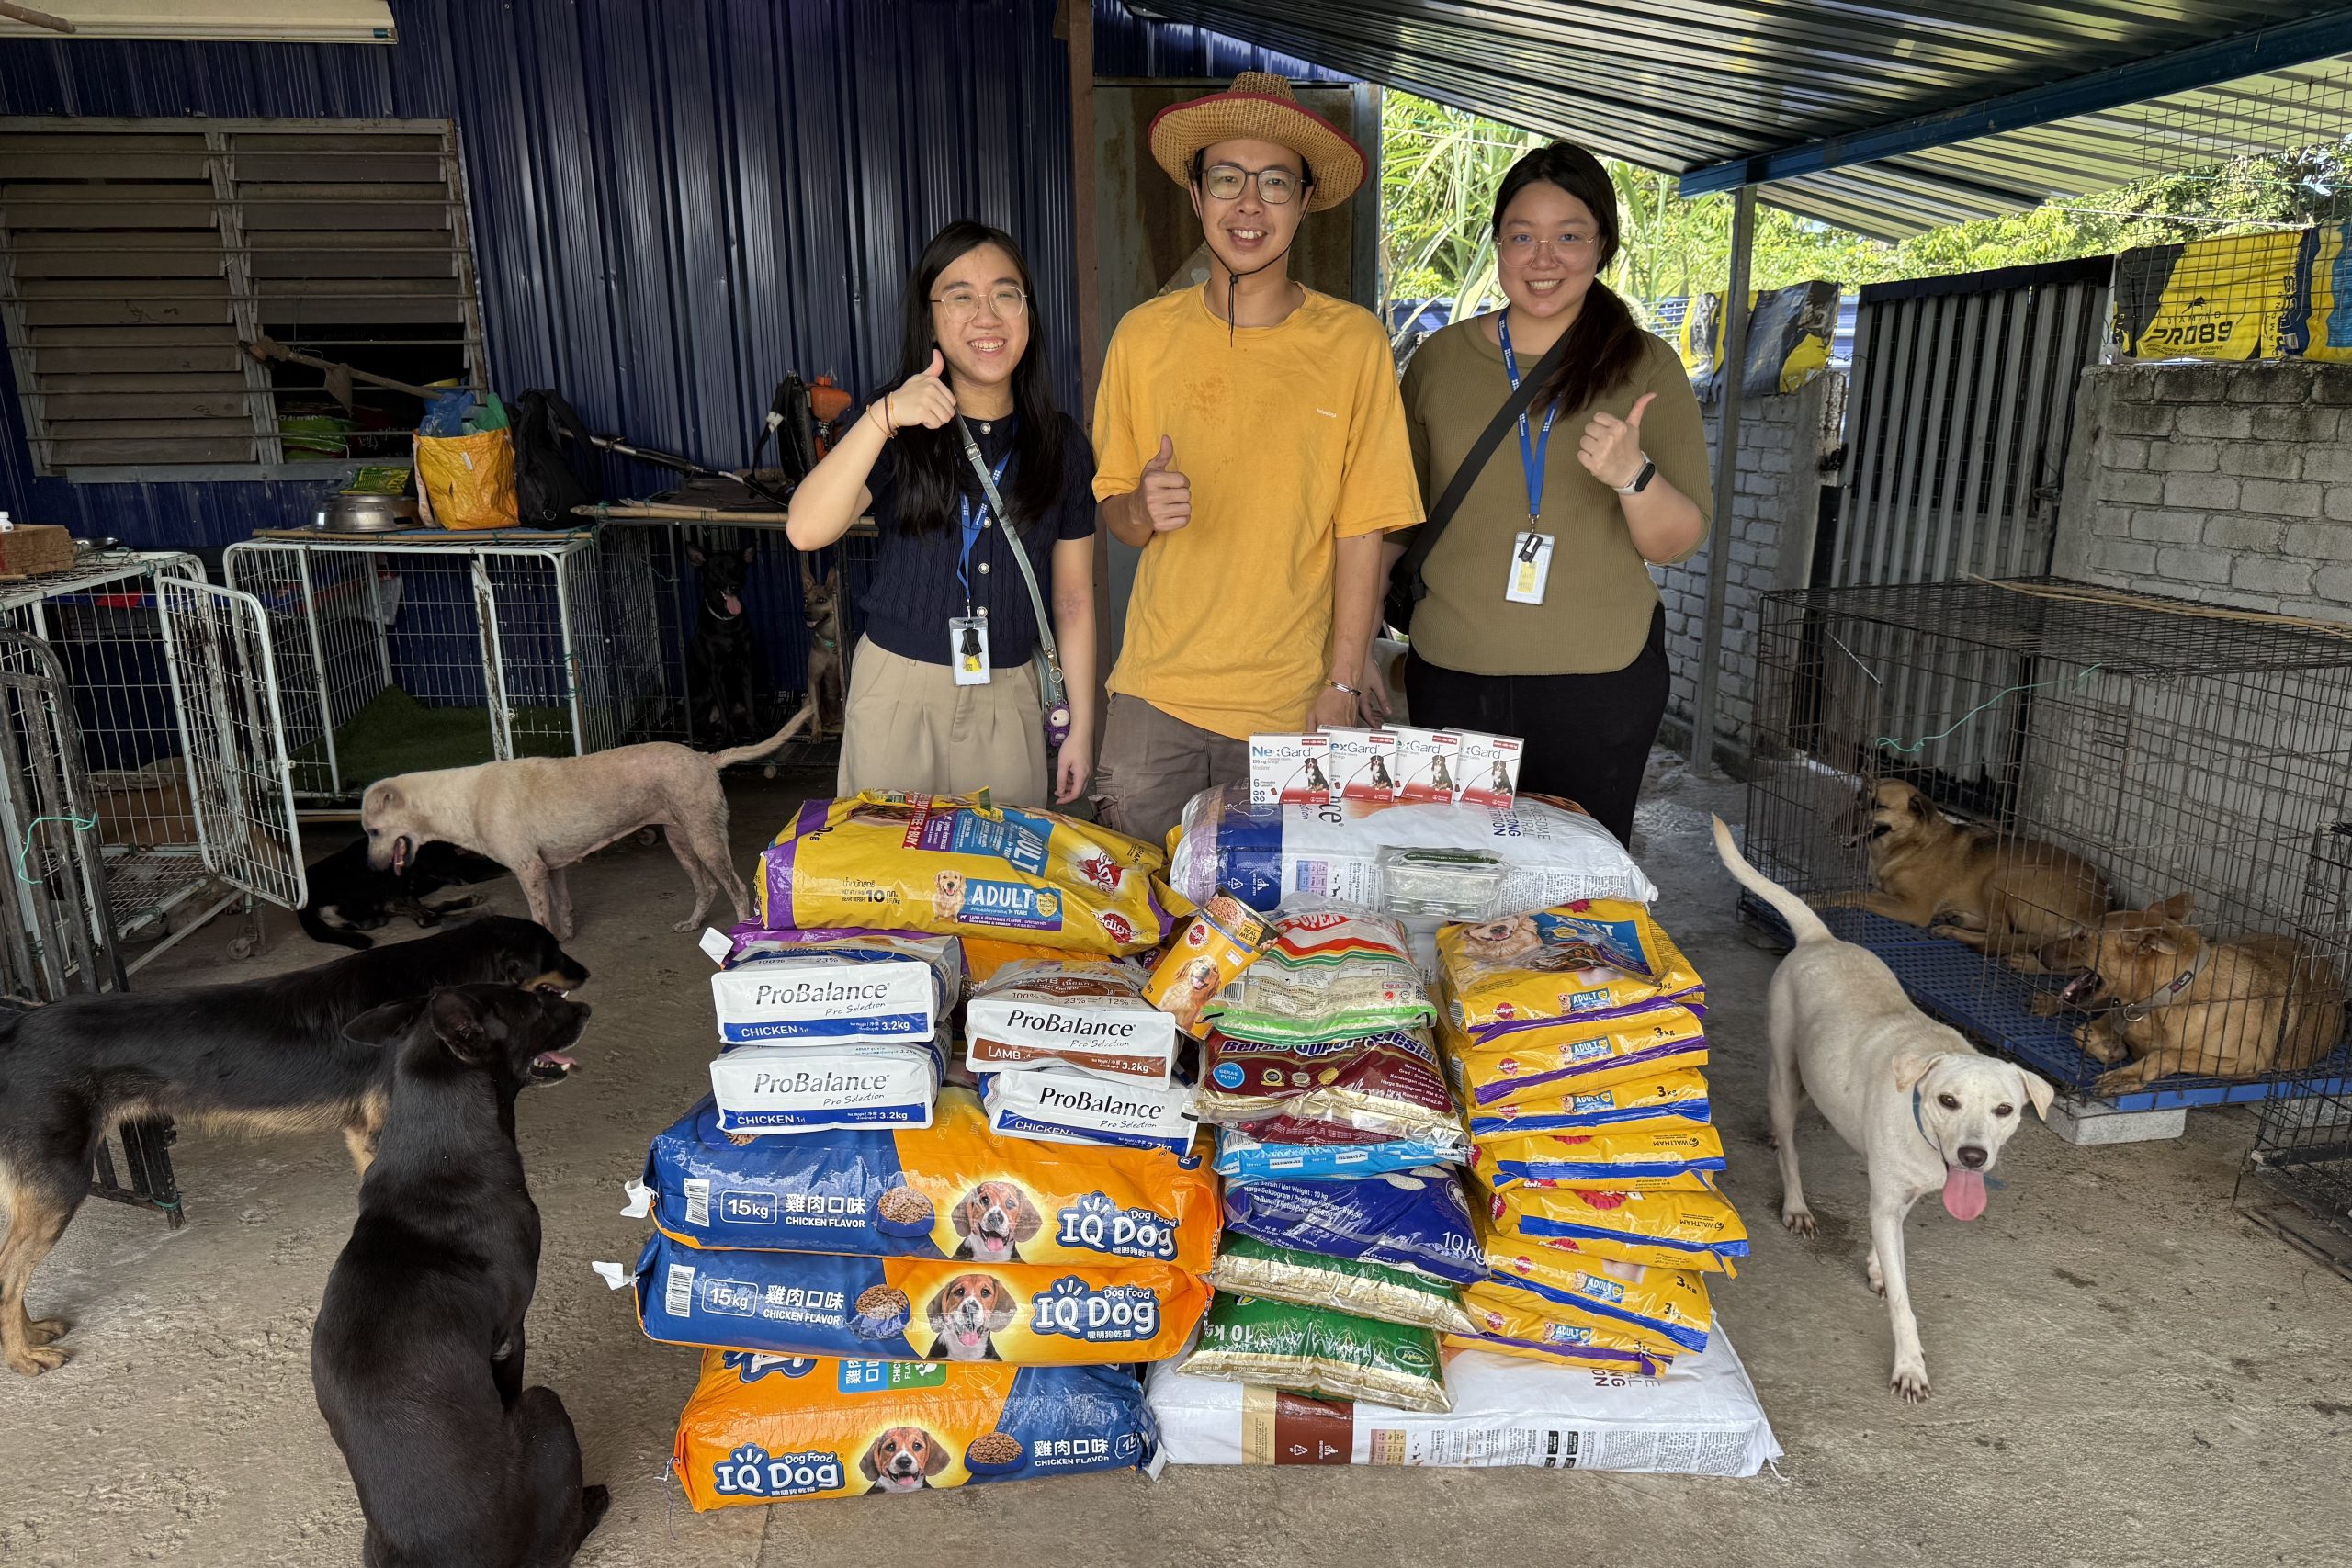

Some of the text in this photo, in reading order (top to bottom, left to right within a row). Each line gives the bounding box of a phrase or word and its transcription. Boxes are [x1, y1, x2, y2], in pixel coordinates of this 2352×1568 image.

[904, 831, 918, 845] BUY
[865, 889, 885, 903] 10
[971, 884, 1034, 908] ADULT
[1238, 931, 1256, 942] MEAT
[1243, 928, 1257, 938] REAL
[756, 981, 888, 1005] ProBalance
[1573, 991, 1597, 1003] ADULT
[825, 1001, 886, 1016] Pro Selection
[881, 1021, 910, 1031] 3.2kg
[1006, 1010, 1135, 1037] ProBalance
[741, 1025, 798, 1037] CHICKEN
[1070, 1039, 1130, 1048] Pro Selection
[1574, 1042, 1597, 1054] ADULT
[988, 1045, 1022, 1060] LAMB
[1121, 1061, 1149, 1074] 3.2kg
[1218, 1067, 1238, 1076] BERAS
[754, 1071, 888, 1093] ProBalance
[823, 1092, 885, 1107] Pro Selection
[1038, 1087, 1163, 1119] ProBalance
[1575, 1093, 1600, 1104] ADULT
[737, 1114, 795, 1124] CHICKEN
[879, 1111, 908, 1120] 3.2kg
[1014, 1121, 1069, 1135] CHICKEN
[1100, 1120, 1157, 1129] Pro Selection
[1653, 1139, 1689, 1147] WALTHAM
[1292, 1185, 1310, 1195] Weight
[728, 1199, 769, 1219] 15kg
[786, 1193, 865, 1215] 雞肉口味
[786, 1216, 865, 1228] CHICKEN FLAVOR
[1131, 1209, 1177, 1227] Dog Food
[1679, 1219, 1715, 1229] WALTHAM
[1062, 1213, 1173, 1256] IQ Dog
[1588, 1277, 1611, 1291] ADULT
[710, 1288, 749, 1310] 15kg
[765, 1285, 844, 1311] 雞肉口味
[1104, 1287, 1150, 1300] Dog Food
[763, 1309, 841, 1325] CHICKEN FLAVOR
[1035, 1296, 1156, 1334] IQ Dog
[1231, 1325, 1253, 1341] 10
[1556, 1325, 1579, 1337] ADULT
[1034, 1438, 1109, 1458] 雞肉口味
[785, 1452, 834, 1464] Dog Food
[1035, 1458, 1073, 1467] CHICKEN
[718, 1463, 838, 1494] IQ Dog
